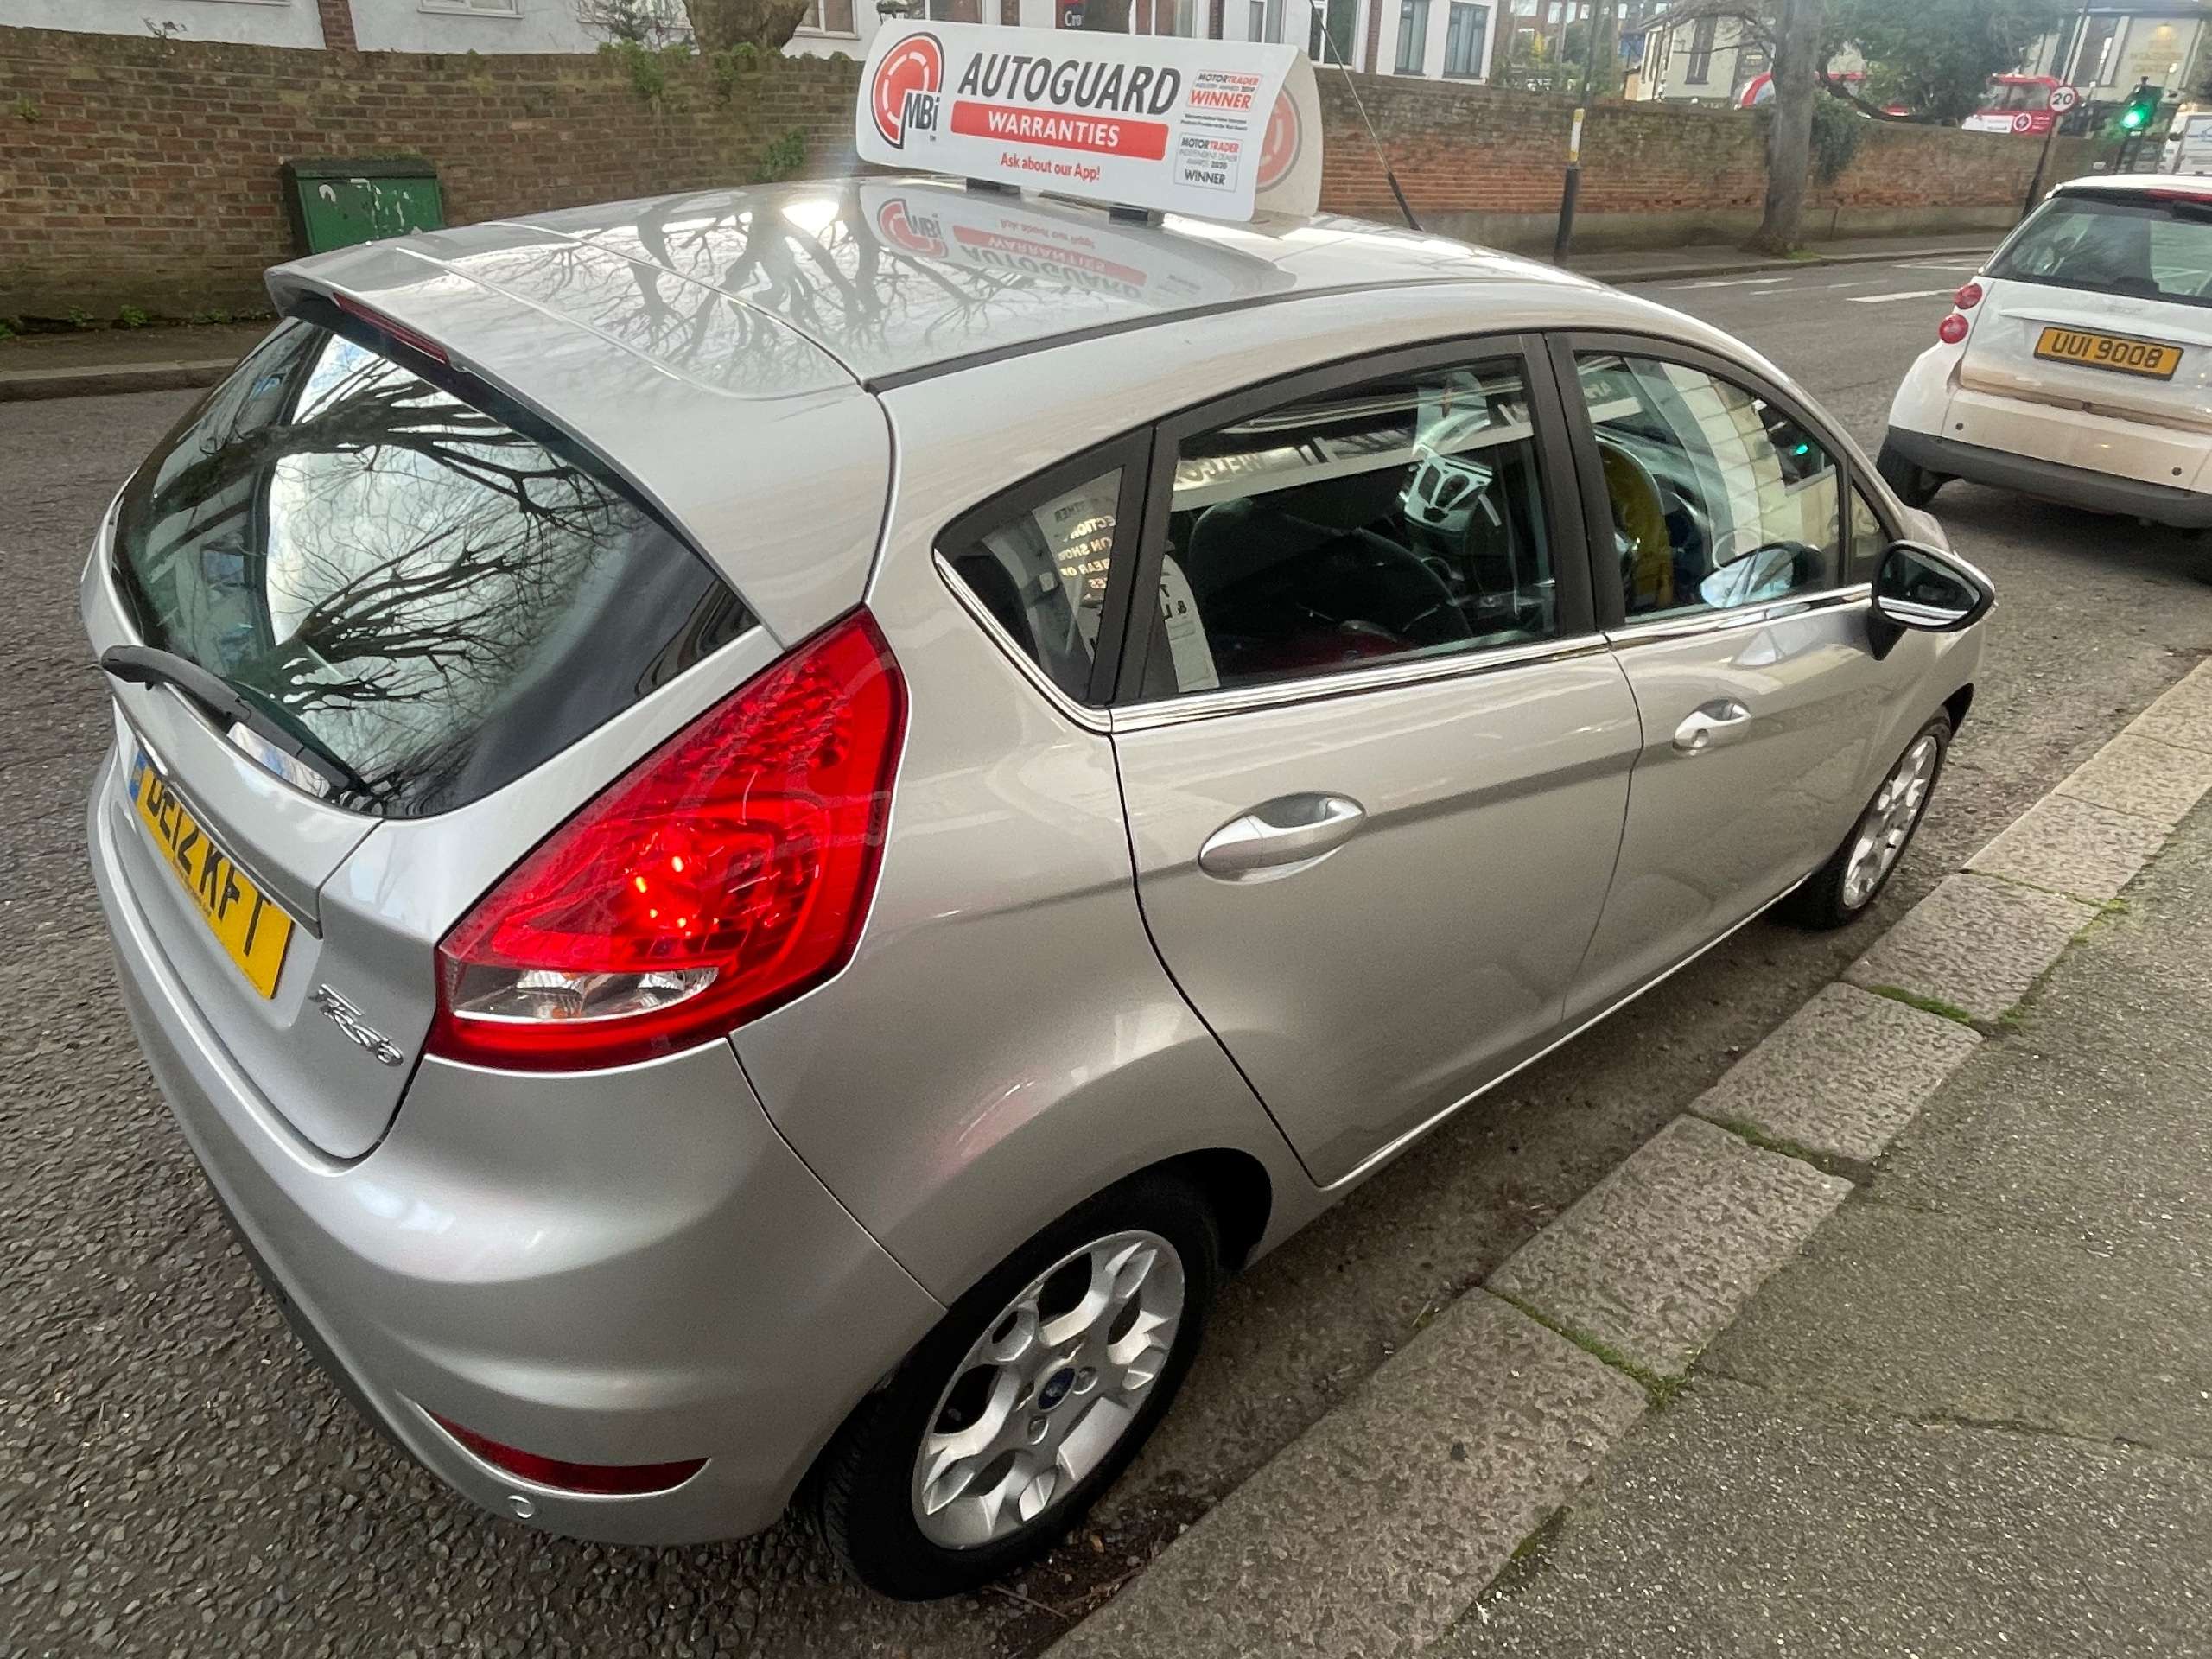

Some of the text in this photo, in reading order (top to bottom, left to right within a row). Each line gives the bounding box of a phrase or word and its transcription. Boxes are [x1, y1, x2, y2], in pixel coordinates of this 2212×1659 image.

[957, 52, 1181, 115] AUTOGUARD
[1197, 73, 1260, 86] MOTORTRADER
[1190, 90, 1252, 109] WINNER
[2052, 93, 2073, 105] 20
[906, 92, 940, 131] MBi
[988, 111, 1121, 149] WARRANTIES
[1181, 137, 1239, 153] MOTORTRADER
[1001, 152, 1101, 182] Ask about our App!
[1185, 168, 1225, 186] WINNER
[2051, 333, 2163, 369] UUI 9008
